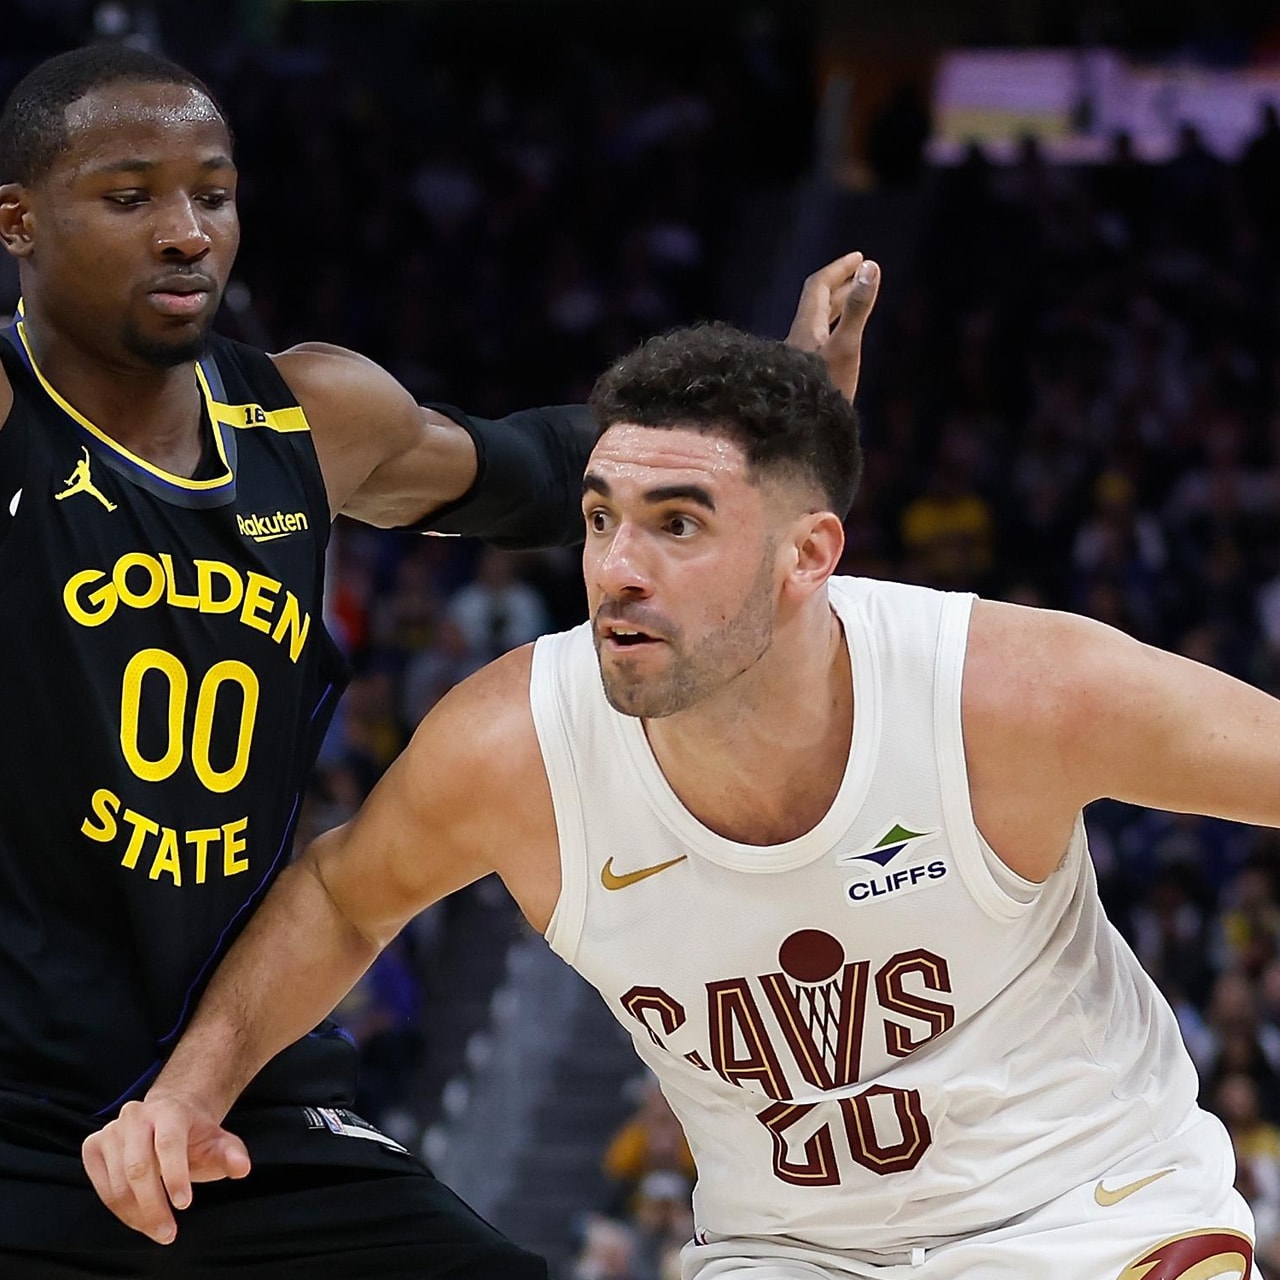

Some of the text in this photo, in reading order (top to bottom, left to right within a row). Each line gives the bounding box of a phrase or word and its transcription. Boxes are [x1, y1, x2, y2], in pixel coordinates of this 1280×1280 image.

[236, 511, 308, 536] Rakuten
[63, 552, 311, 664] GOLDEN
[120, 648, 259, 794] 00
[80, 788, 249, 887] STATE
[848, 860, 947, 901] CLIFFS
